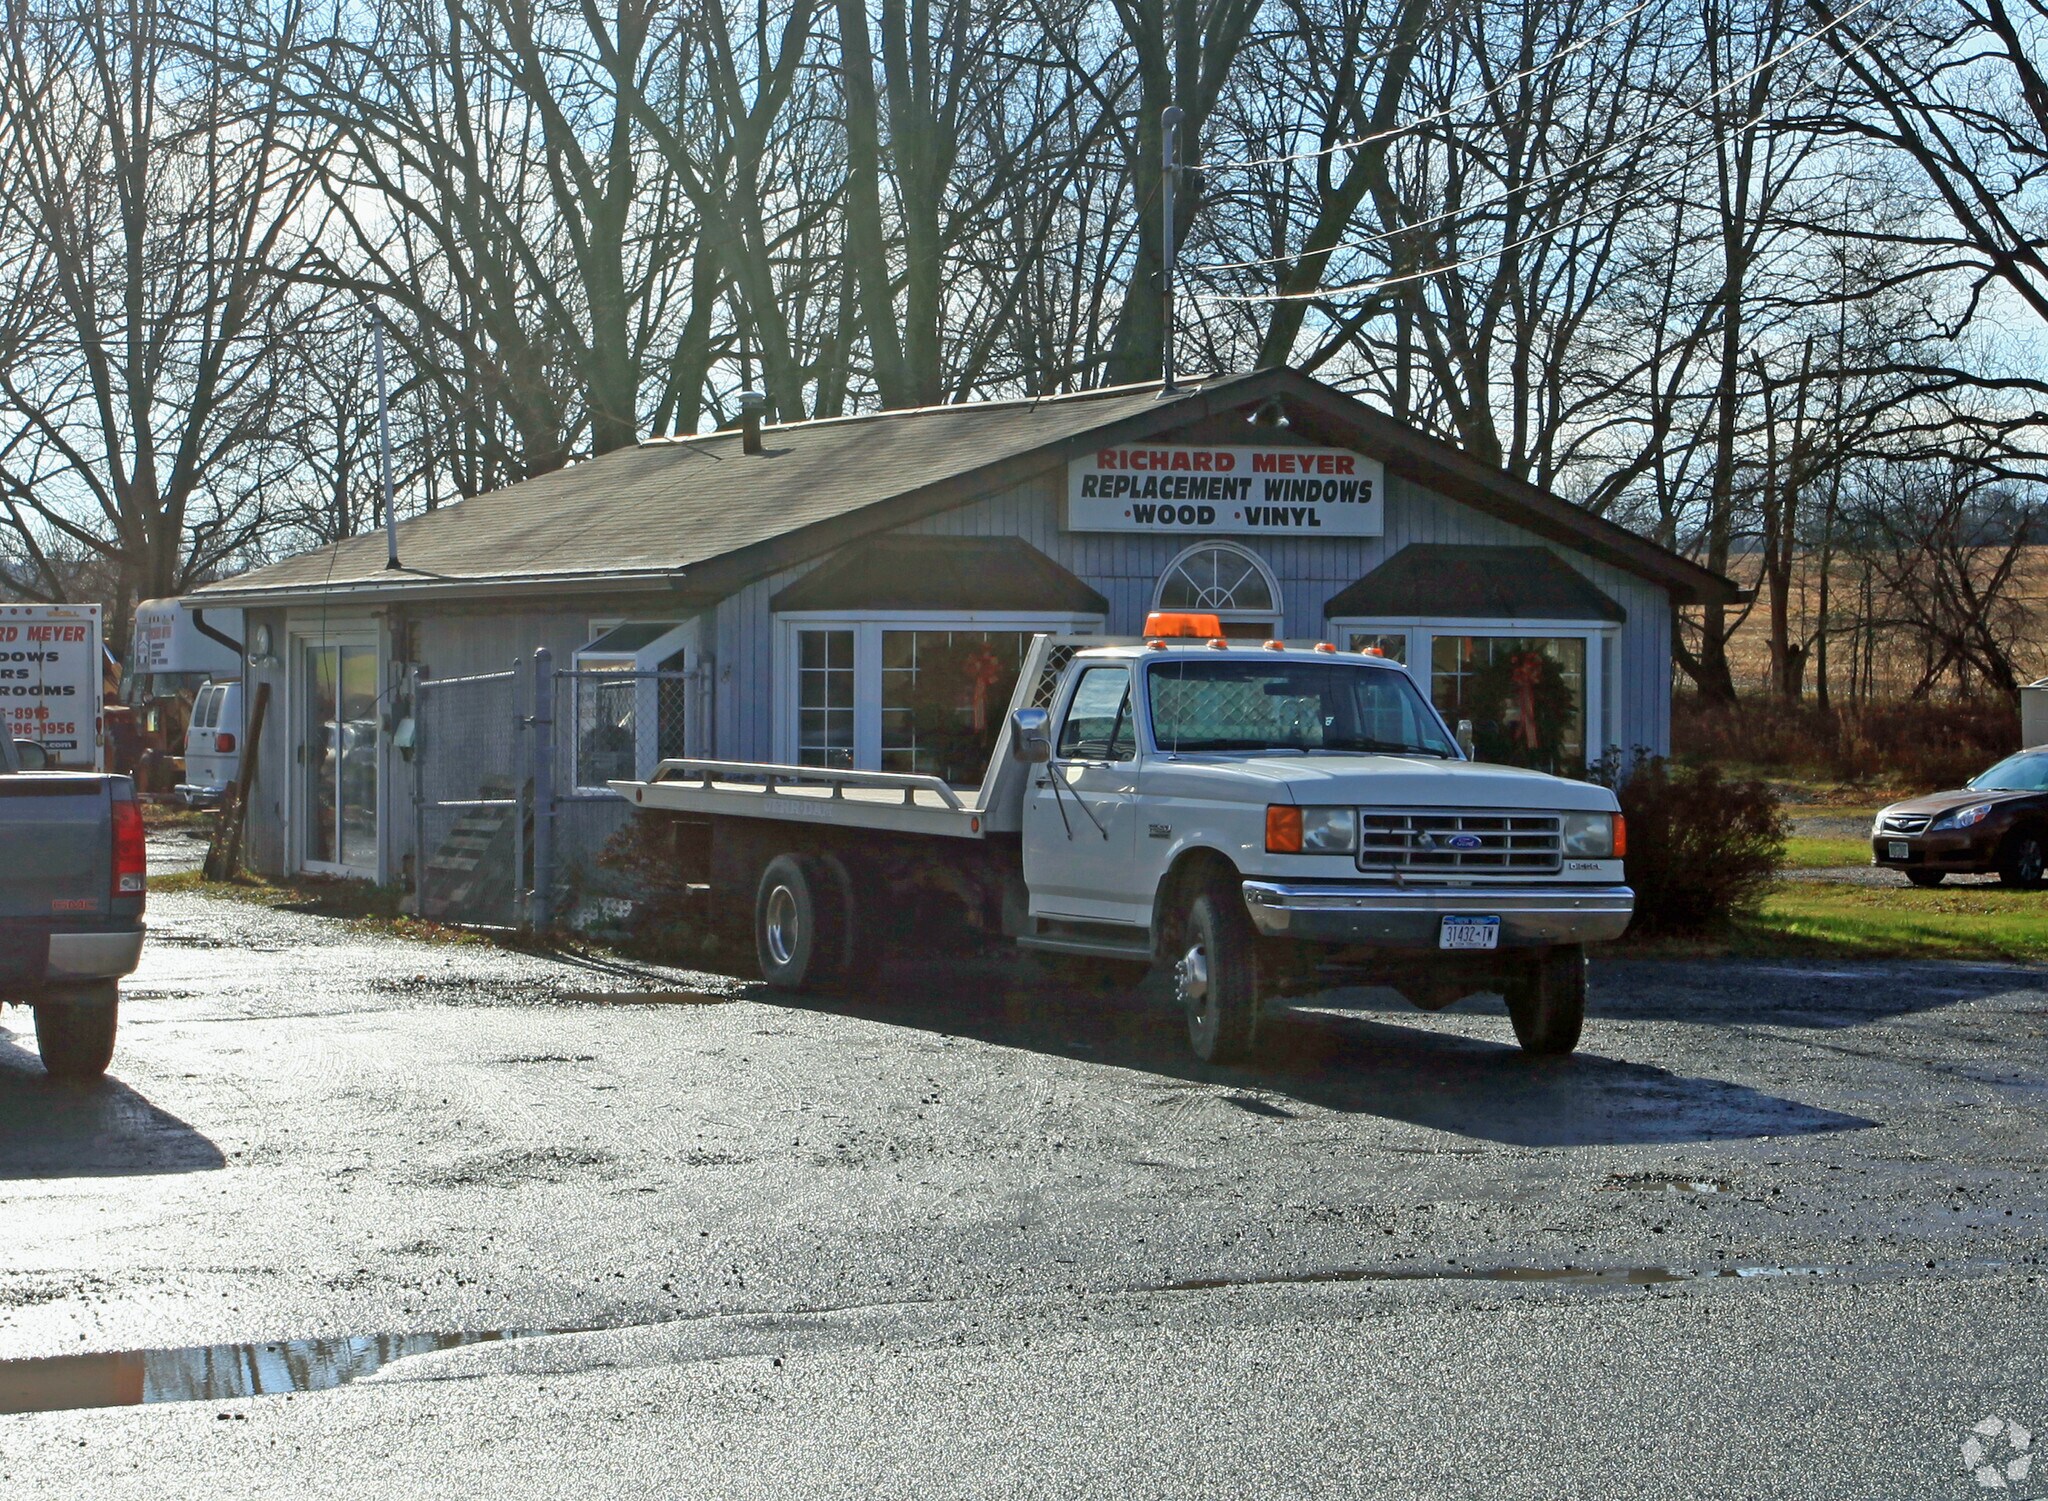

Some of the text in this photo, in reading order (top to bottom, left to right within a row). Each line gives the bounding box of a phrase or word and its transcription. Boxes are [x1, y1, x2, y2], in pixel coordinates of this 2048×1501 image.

[1097, 450, 1355, 475] RICHARD MEYER
[1081, 474, 1373, 504] REPLACEMENT WINDOWS
[1133, 504, 1321, 527] WOOD VINYL
[27, 626, 86, 642] MEYER
[1, 669, 29, 679] RS
[0, 686, 76, 696] ROOMS
[52, 899, 97, 911] GMC
